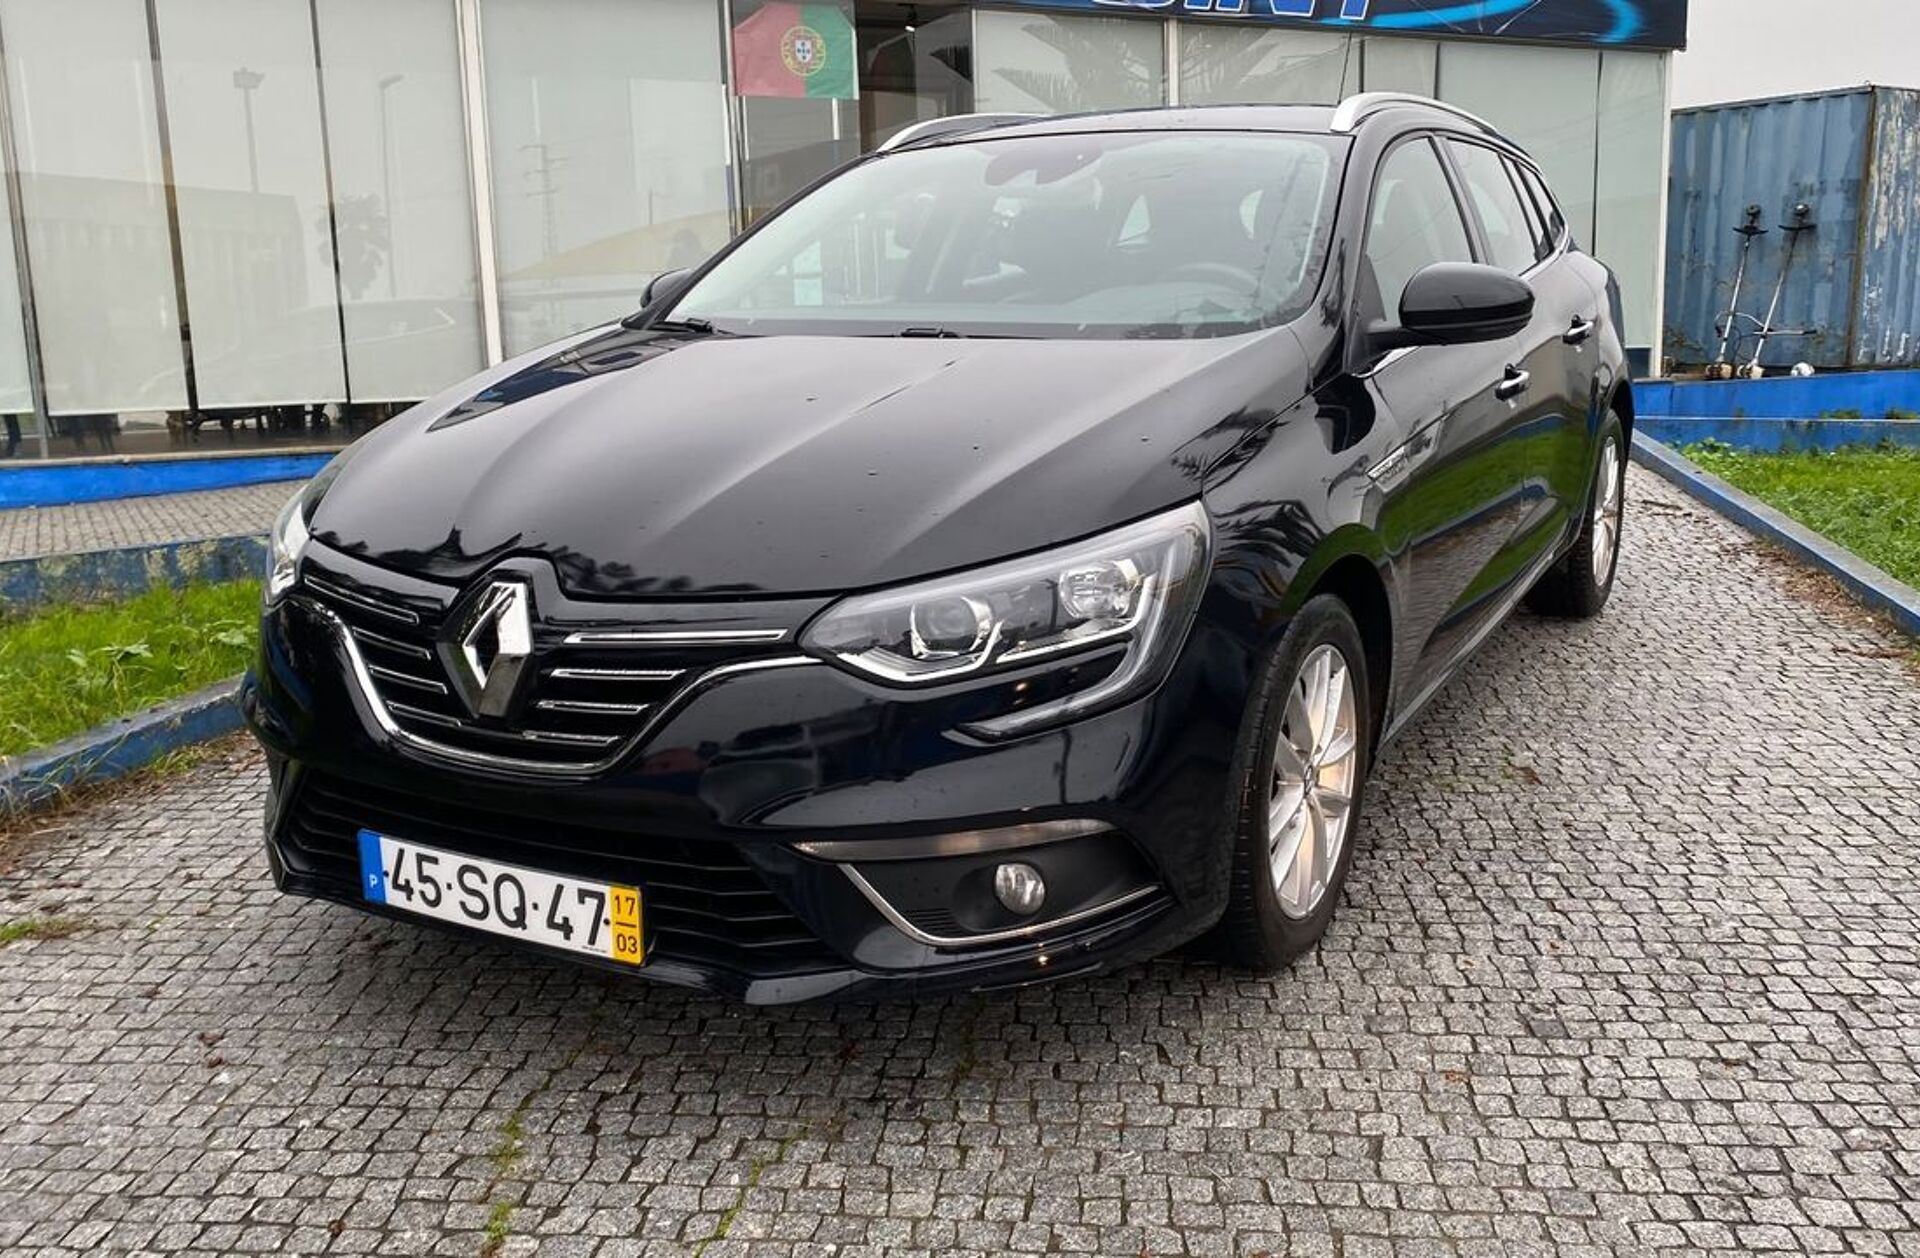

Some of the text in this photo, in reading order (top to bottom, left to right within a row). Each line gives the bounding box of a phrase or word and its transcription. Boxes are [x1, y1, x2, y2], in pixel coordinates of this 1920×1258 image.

[369, 873, 378, 888] P
[614, 894, 636, 916] 17
[616, 933, 638, 955] 03
